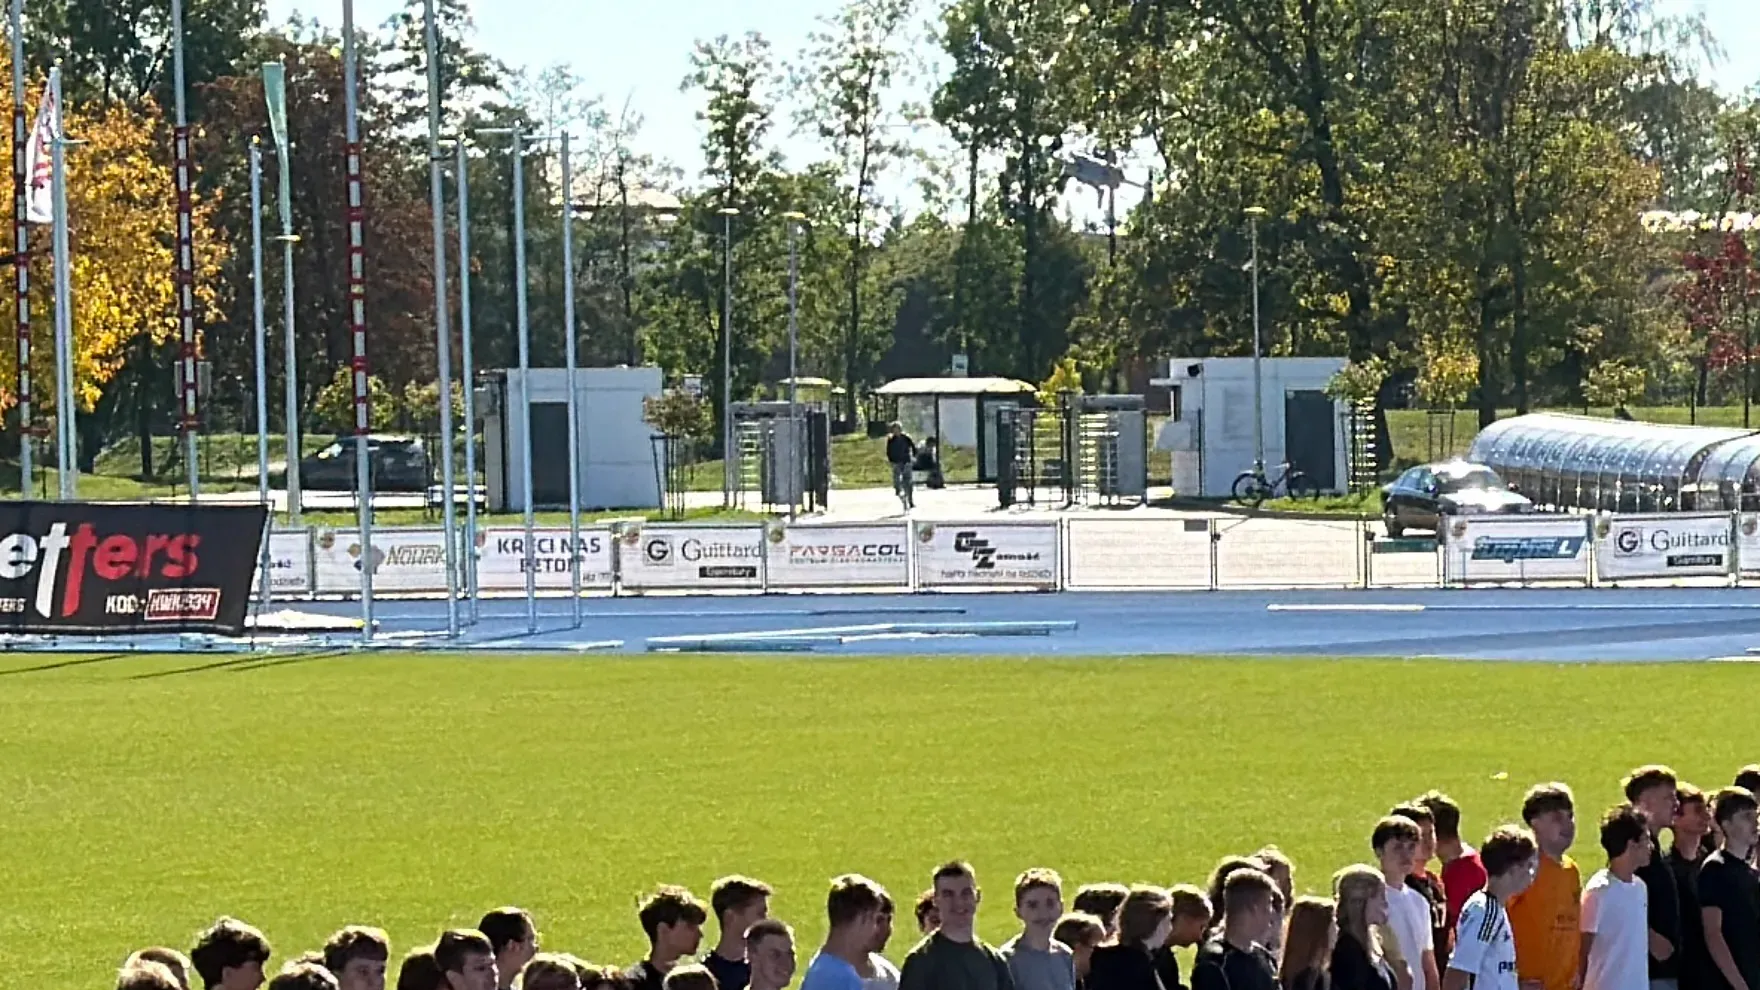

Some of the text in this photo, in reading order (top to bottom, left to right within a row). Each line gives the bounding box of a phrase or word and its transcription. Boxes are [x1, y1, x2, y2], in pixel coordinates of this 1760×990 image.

[497, 538, 554, 554] KRCI
[681, 538, 762, 561] Guittard
[1651, 529, 1729, 551] Guittard
